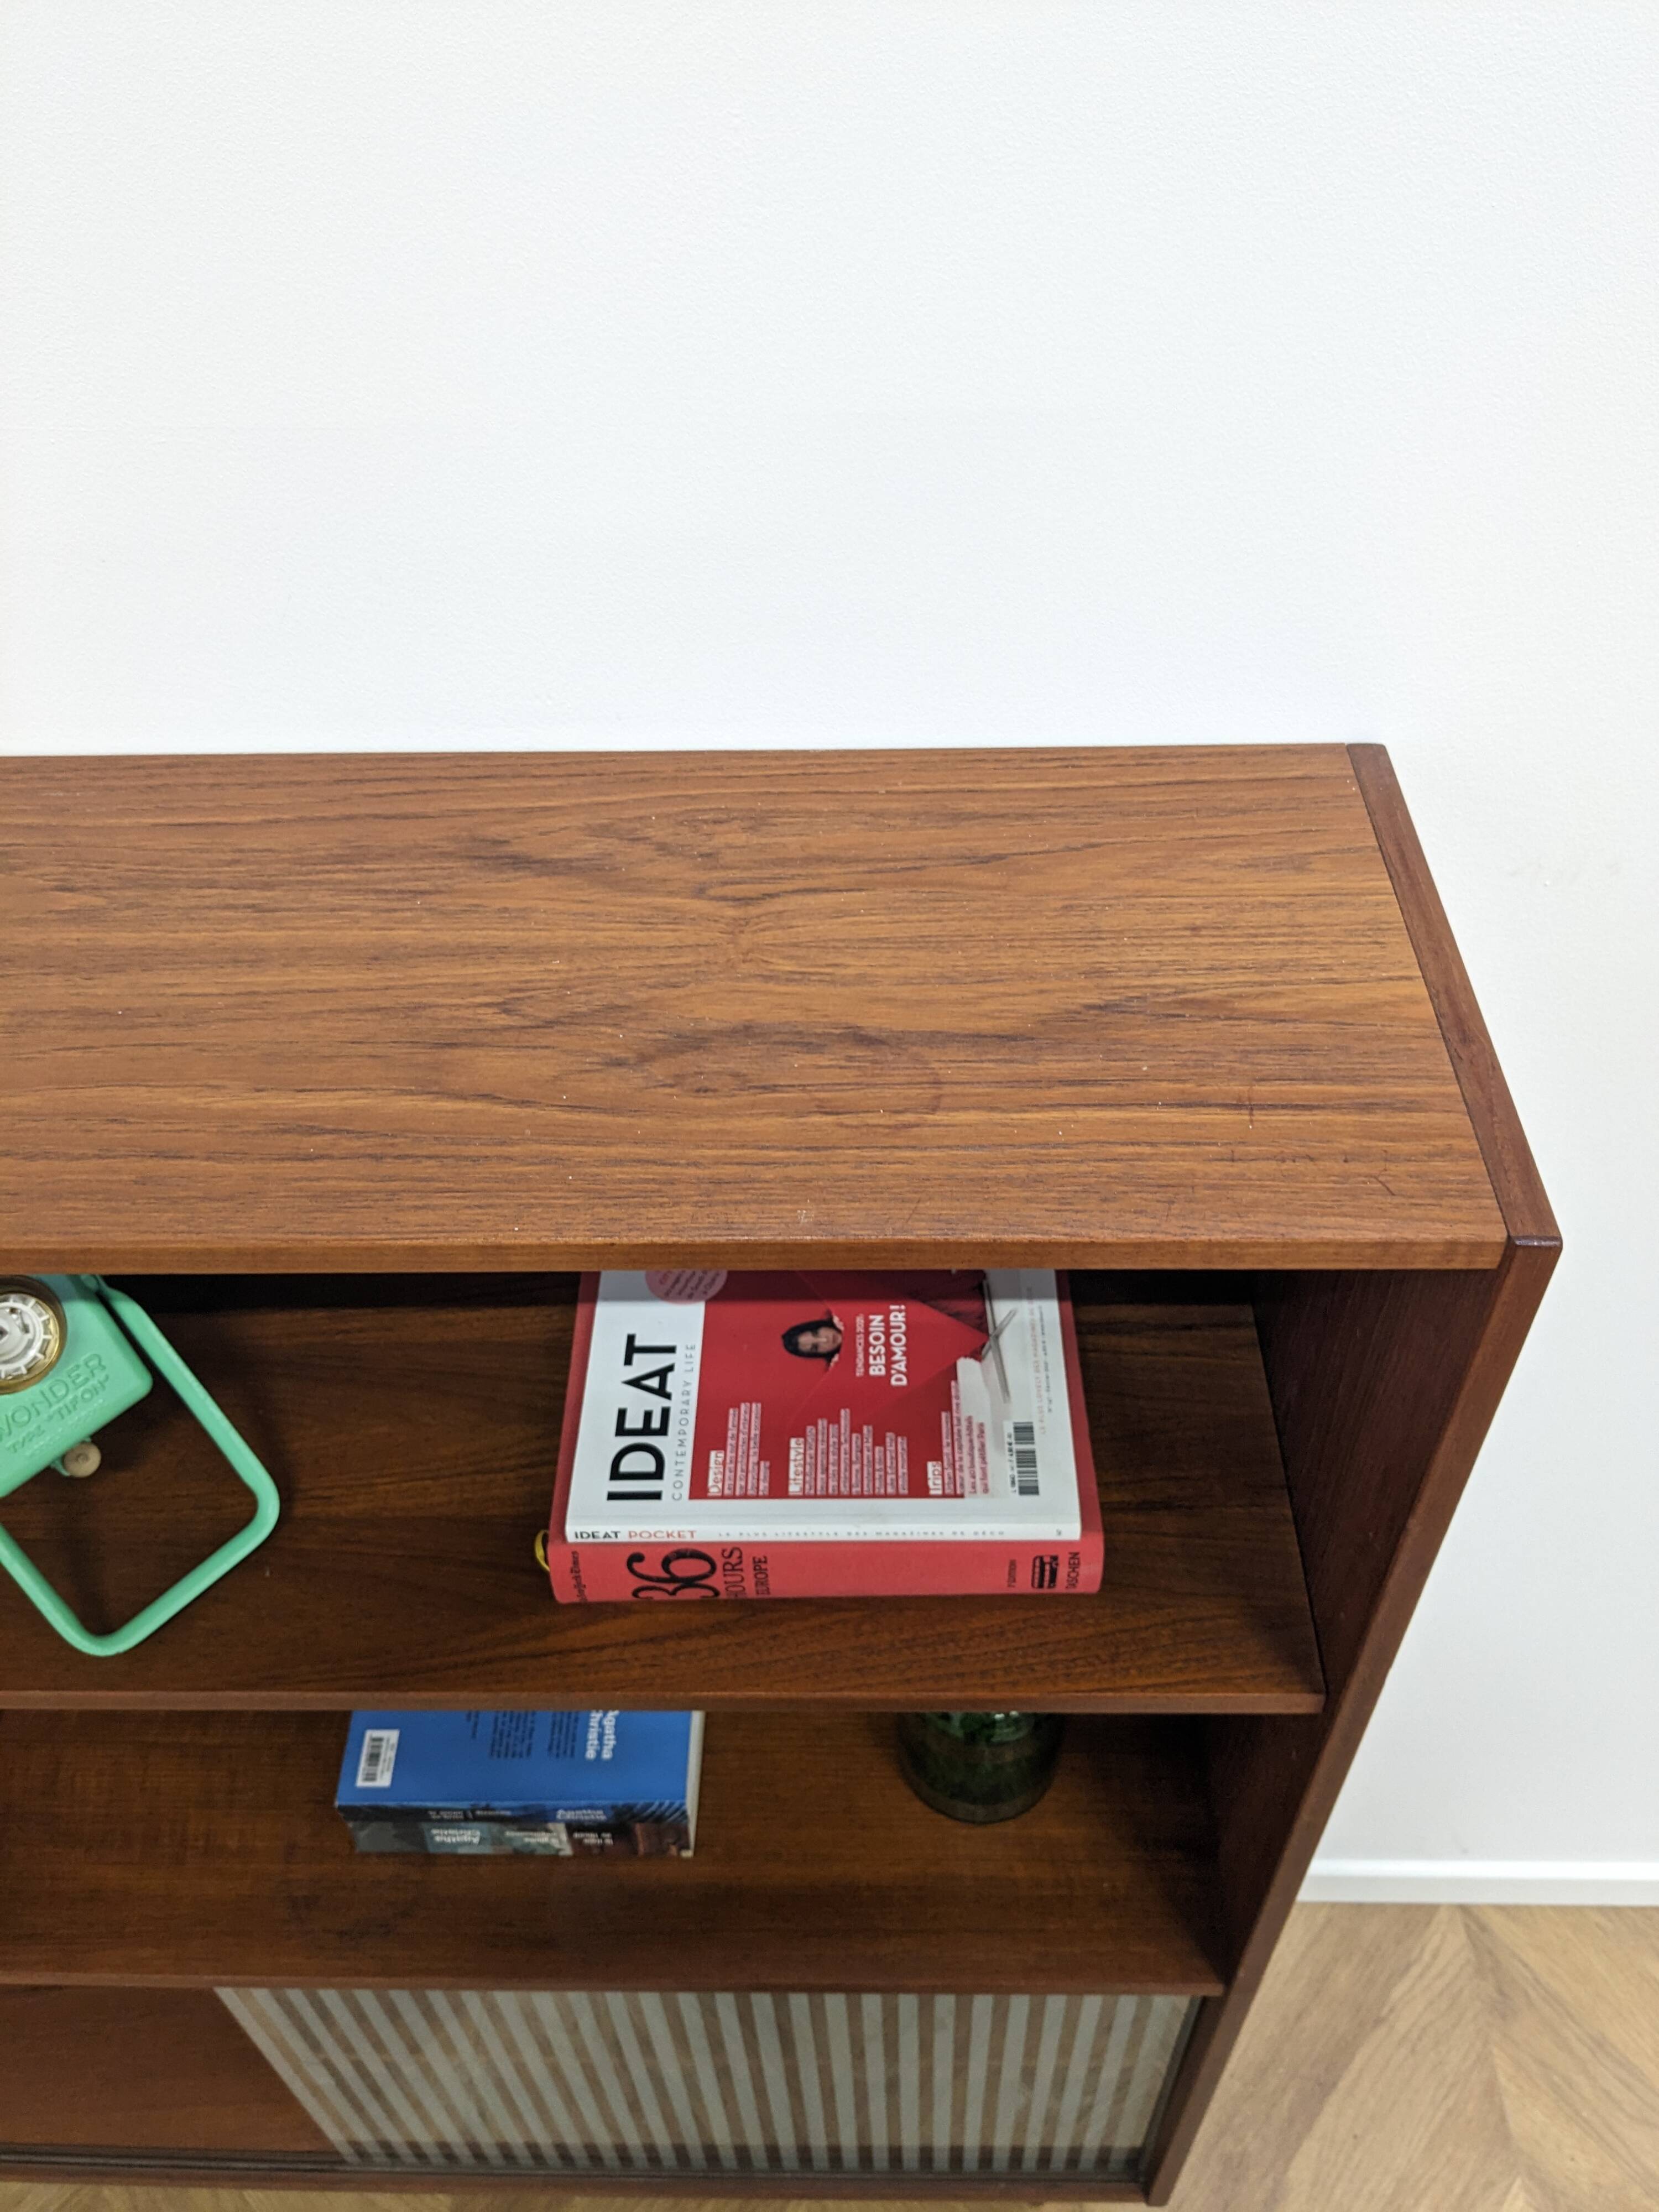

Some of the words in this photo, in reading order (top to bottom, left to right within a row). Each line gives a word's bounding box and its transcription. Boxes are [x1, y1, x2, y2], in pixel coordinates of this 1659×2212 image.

[869, 1314, 886, 1376] BESOIN
[607, 1333, 676, 1501] IDEAT
[672, 1380, 692, 1501] CONTEMPORARY
[684, 1343, 697, 1373] LIFE
[708, 1451, 725, 1494] Design
[790, 1439, 804, 1493] Lifestyle
[927, 1462, 942, 1495] Trips
[957, 1464, 963, 1473] de
[574, 1531, 621, 1540] IDEAT
[628, 1530, 697, 1539] POCKET
[627, 1548, 721, 1600] 36
[721, 1546, 748, 1599] HOURS
[752, 1555, 771, 1596] EUROPE
[1065, 1552, 1081, 1589] TASCHEN
